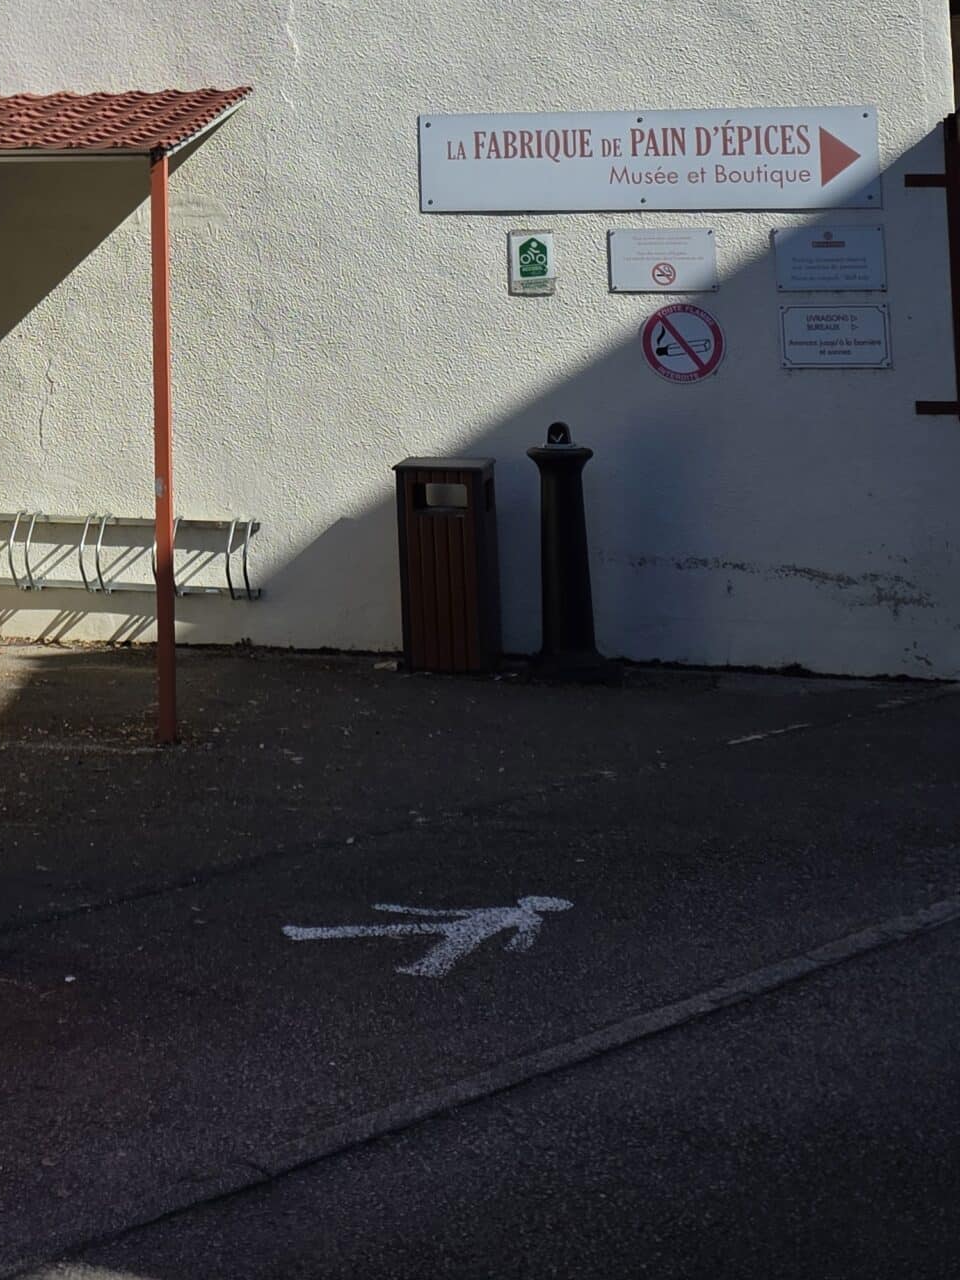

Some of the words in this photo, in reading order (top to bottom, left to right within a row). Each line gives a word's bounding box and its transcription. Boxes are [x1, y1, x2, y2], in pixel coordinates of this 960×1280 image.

[446, 140, 467, 161] LA
[473, 129, 593, 162] FABRIQUE
[601, 138, 622, 158] DE
[630, 127, 686, 157] PAIN
[695, 120, 812, 157] D'ÉPICES
[609, 165, 679, 185] Musée
[687, 169, 707, 184] et
[715, 164, 812, 189] Boutique
